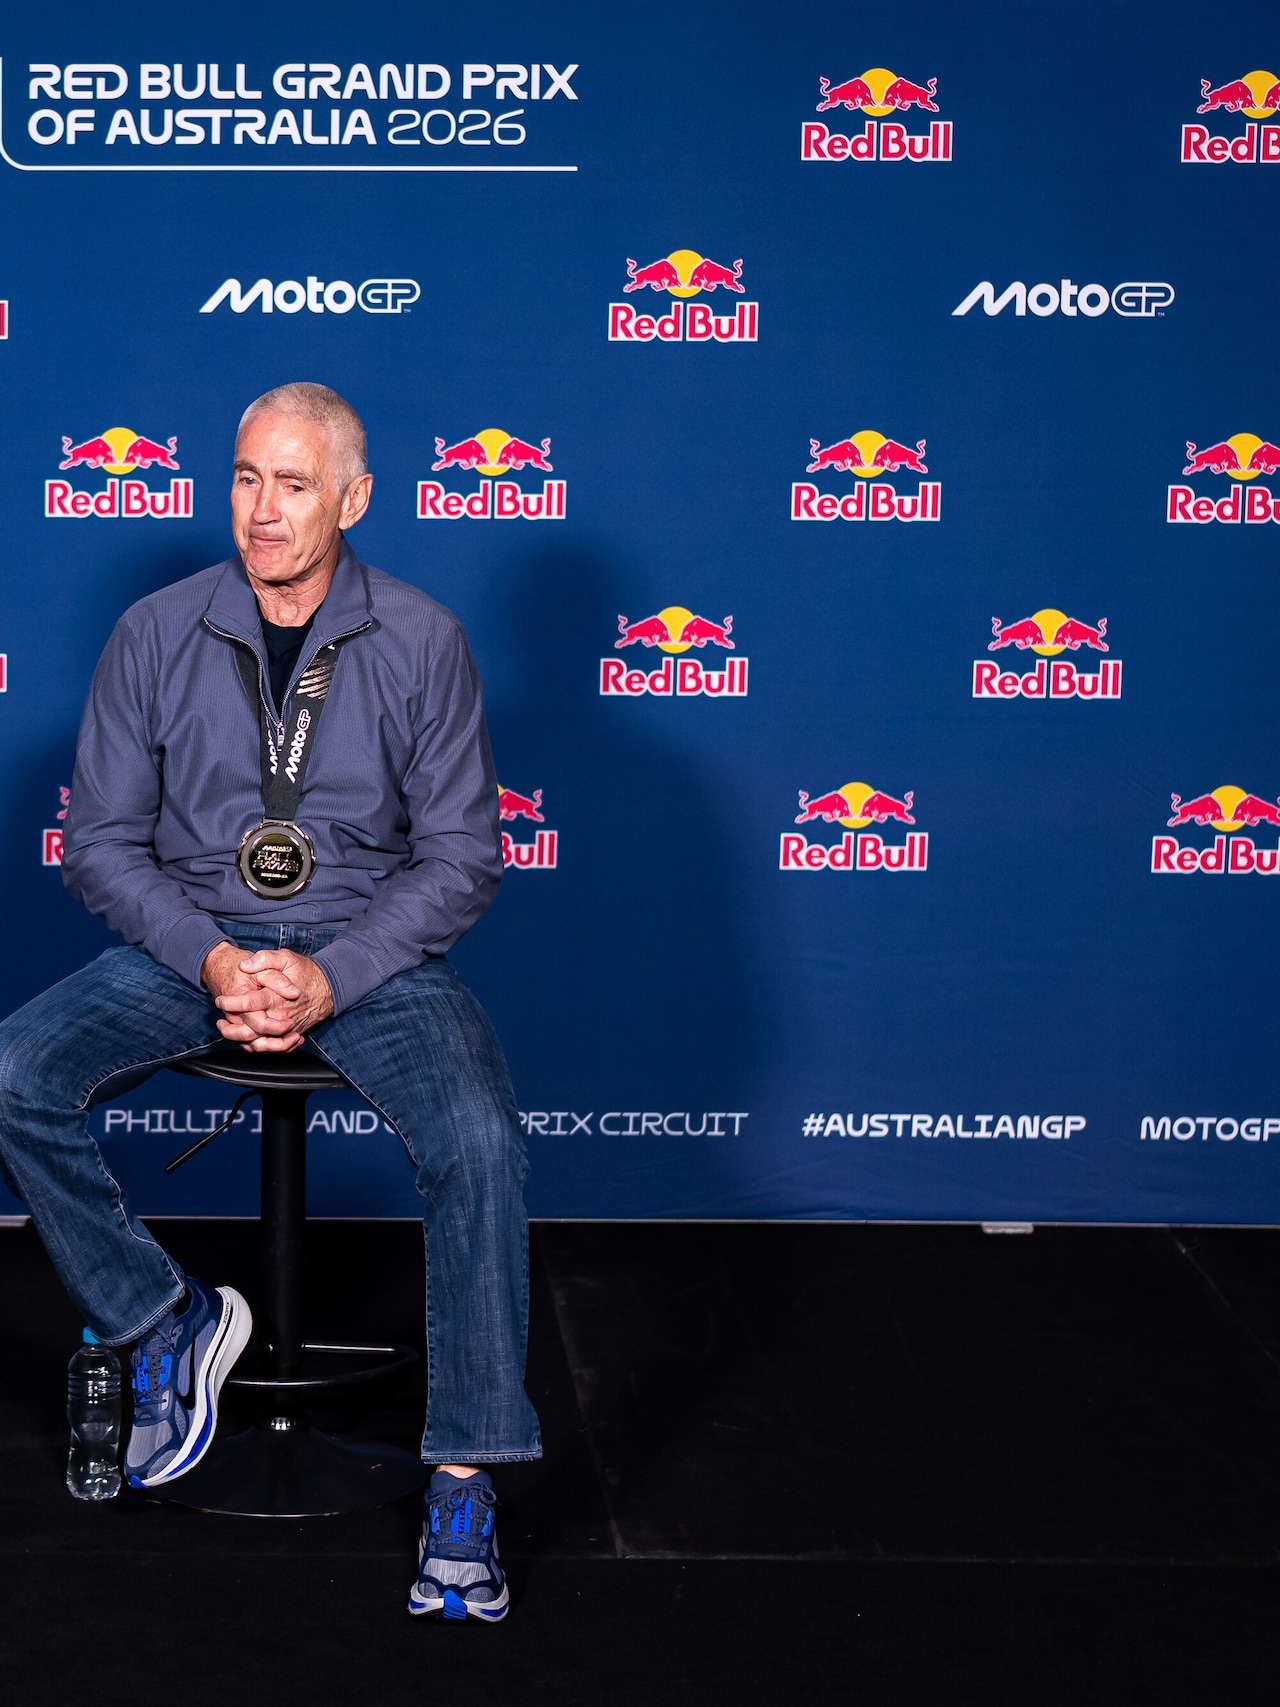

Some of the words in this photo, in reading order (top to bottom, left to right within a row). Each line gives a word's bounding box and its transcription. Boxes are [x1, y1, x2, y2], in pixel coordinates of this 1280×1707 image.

[29, 64, 129, 100] RED
[140, 64, 263, 100] BULL
[273, 64, 452, 100] GRAND
[463, 64, 580, 100] PRIX
[28, 109, 96, 145] OF
[104, 109, 378, 145] AUSTRALIA
[387, 109, 527, 146] 2026
[801, 121, 877, 162] Red
[880, 121, 954, 163] Bull
[1181, 123, 1257, 163] Red
[199, 276, 421, 314] MotoGP
[952, 280, 1176, 317] MotoGP
[608, 302, 683, 342] Red
[686, 302, 759, 343] Bull
[45, 478, 119, 518] Red
[122, 478, 193, 519] Bull
[417, 480, 491, 520] Red
[494, 480, 566, 520] Bull
[791, 482, 866, 521] Red
[869, 482, 942, 522] Bull
[1167, 484, 1242, 524] Red
[600, 657, 674, 696] Red
[676, 657, 749, 697] Bull
[973, 659, 1047, 698] Red
[1050, 660, 1122, 699] Bull
[284, 708, 312, 784] MotoGP
[779, 832, 854, 870] Red
[856, 832, 928, 871] Bull
[1151, 835, 1226, 874] Red
[1228, 837, 1280, 875] Bu
[105, 1109, 245, 1133] PHILLIP
[251, 1110, 379, 1134] IAND
[599, 1112, 749, 1136] CIRCUIT
[801, 1113, 1087, 1139] #AUSTRALIANGP
[1140, 1117, 1280, 1142] MOTOGP
